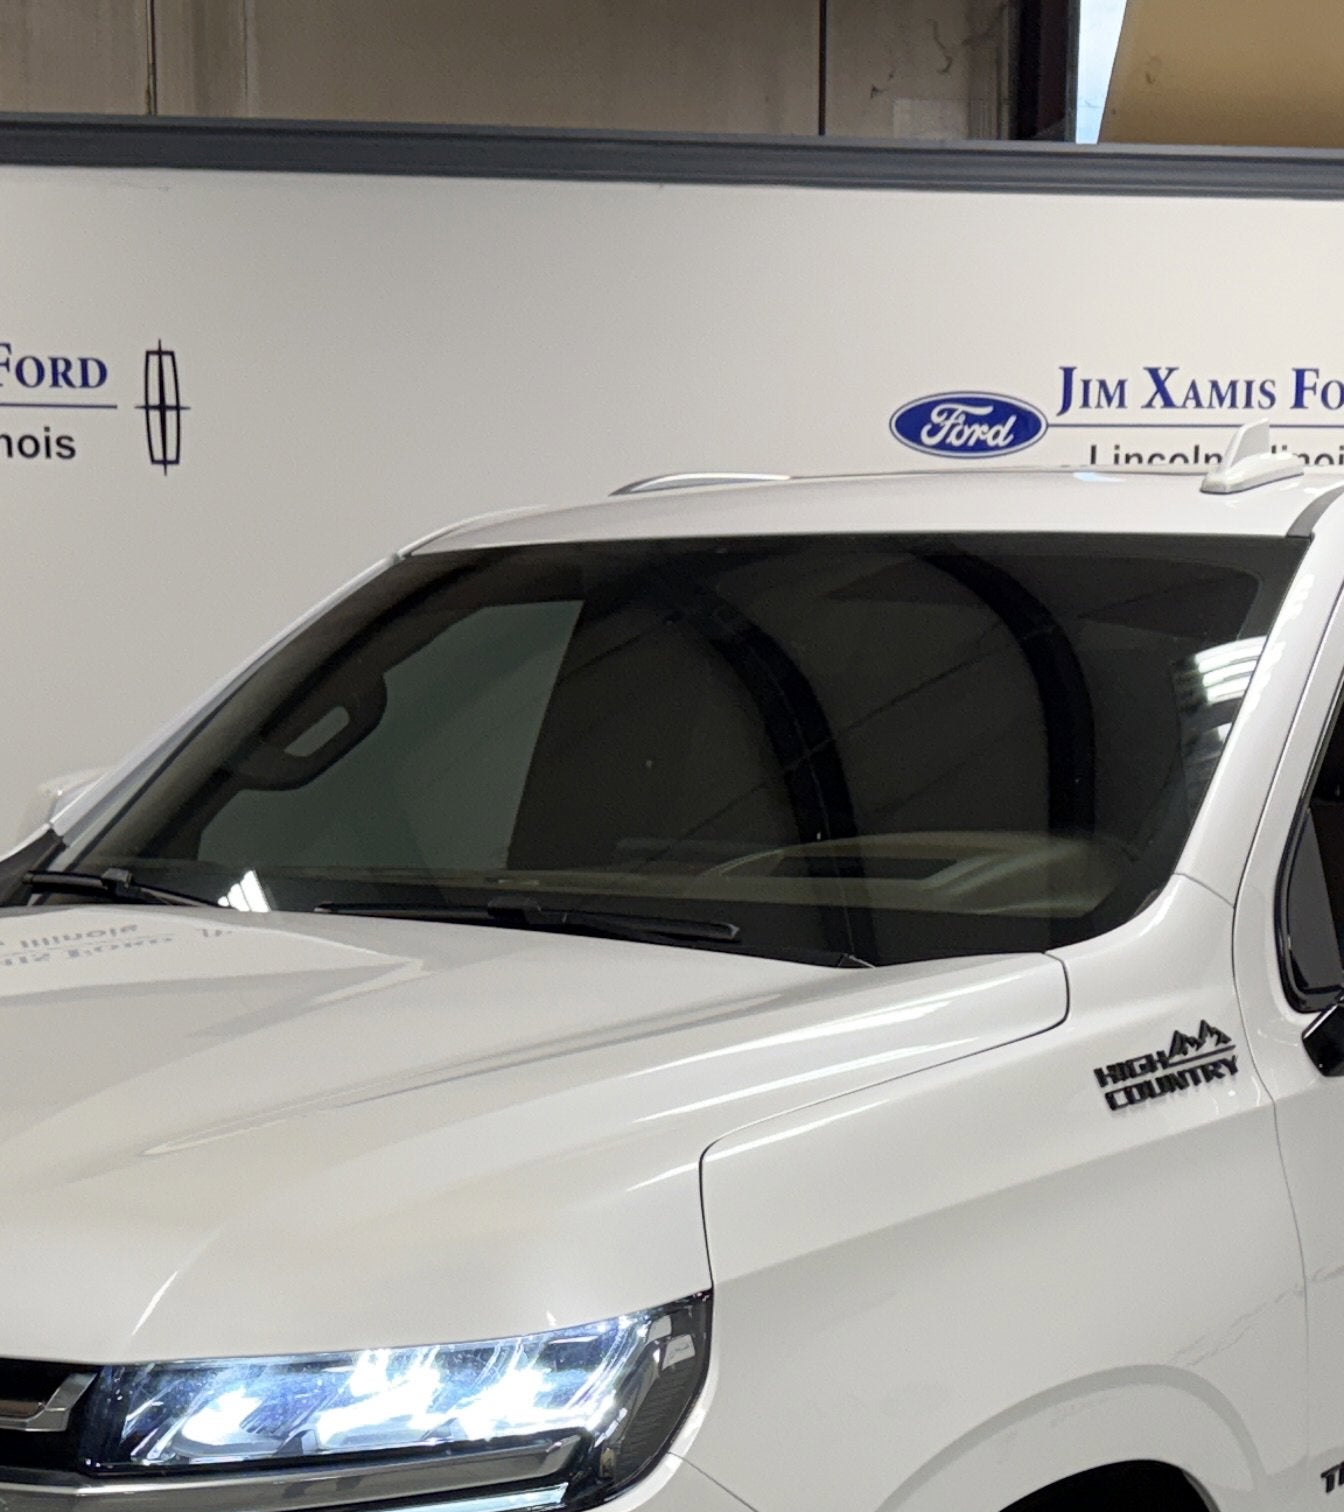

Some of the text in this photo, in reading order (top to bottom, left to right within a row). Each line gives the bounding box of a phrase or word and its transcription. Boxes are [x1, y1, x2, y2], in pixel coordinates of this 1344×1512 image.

[1056, 365, 1129, 417] JIM
[1141, 366, 1277, 410] XAMIS
[919, 404, 1018, 449] Ford
[1093, 1049, 1169, 1088] HIGH
[1104, 1054, 1239, 1111] COUNTRY
